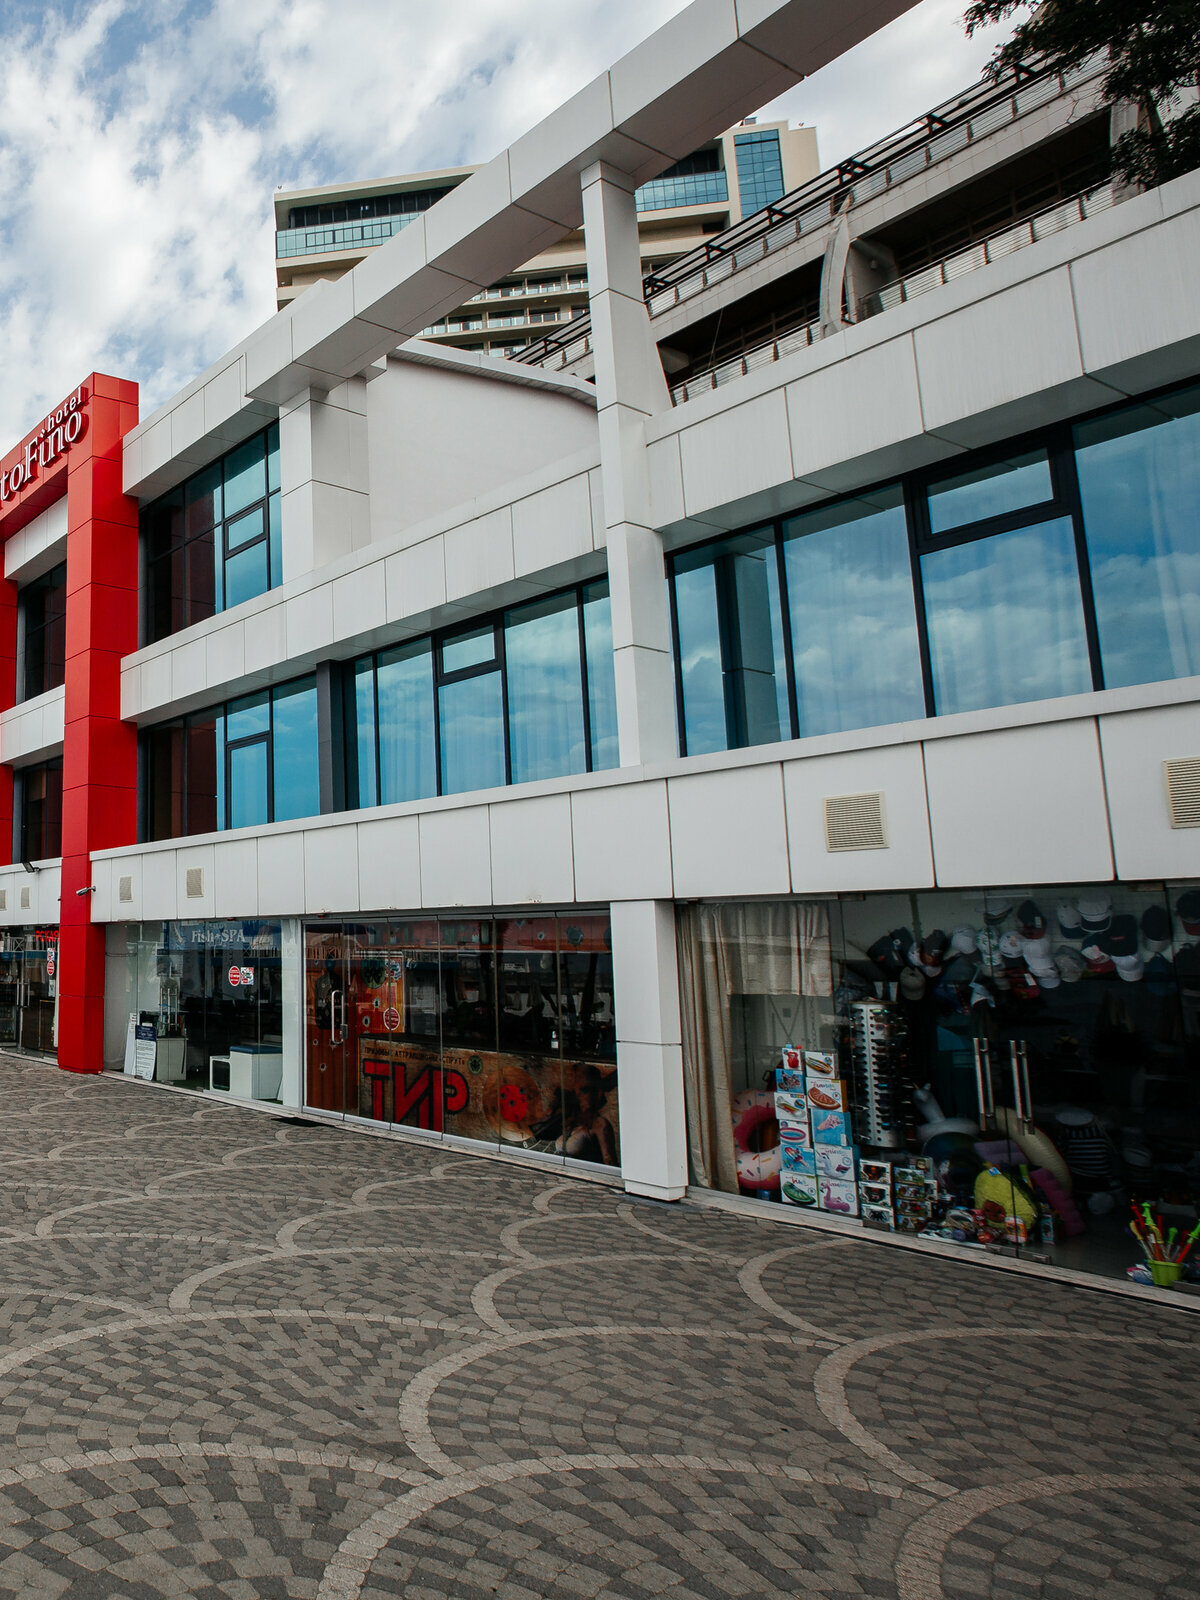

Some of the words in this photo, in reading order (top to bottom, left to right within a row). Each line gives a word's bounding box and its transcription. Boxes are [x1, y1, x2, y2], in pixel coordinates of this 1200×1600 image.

[47, 386, 83, 432] hotel
[221, 928, 246, 942] SPA
[364, 1058, 470, 1133] ТИР
